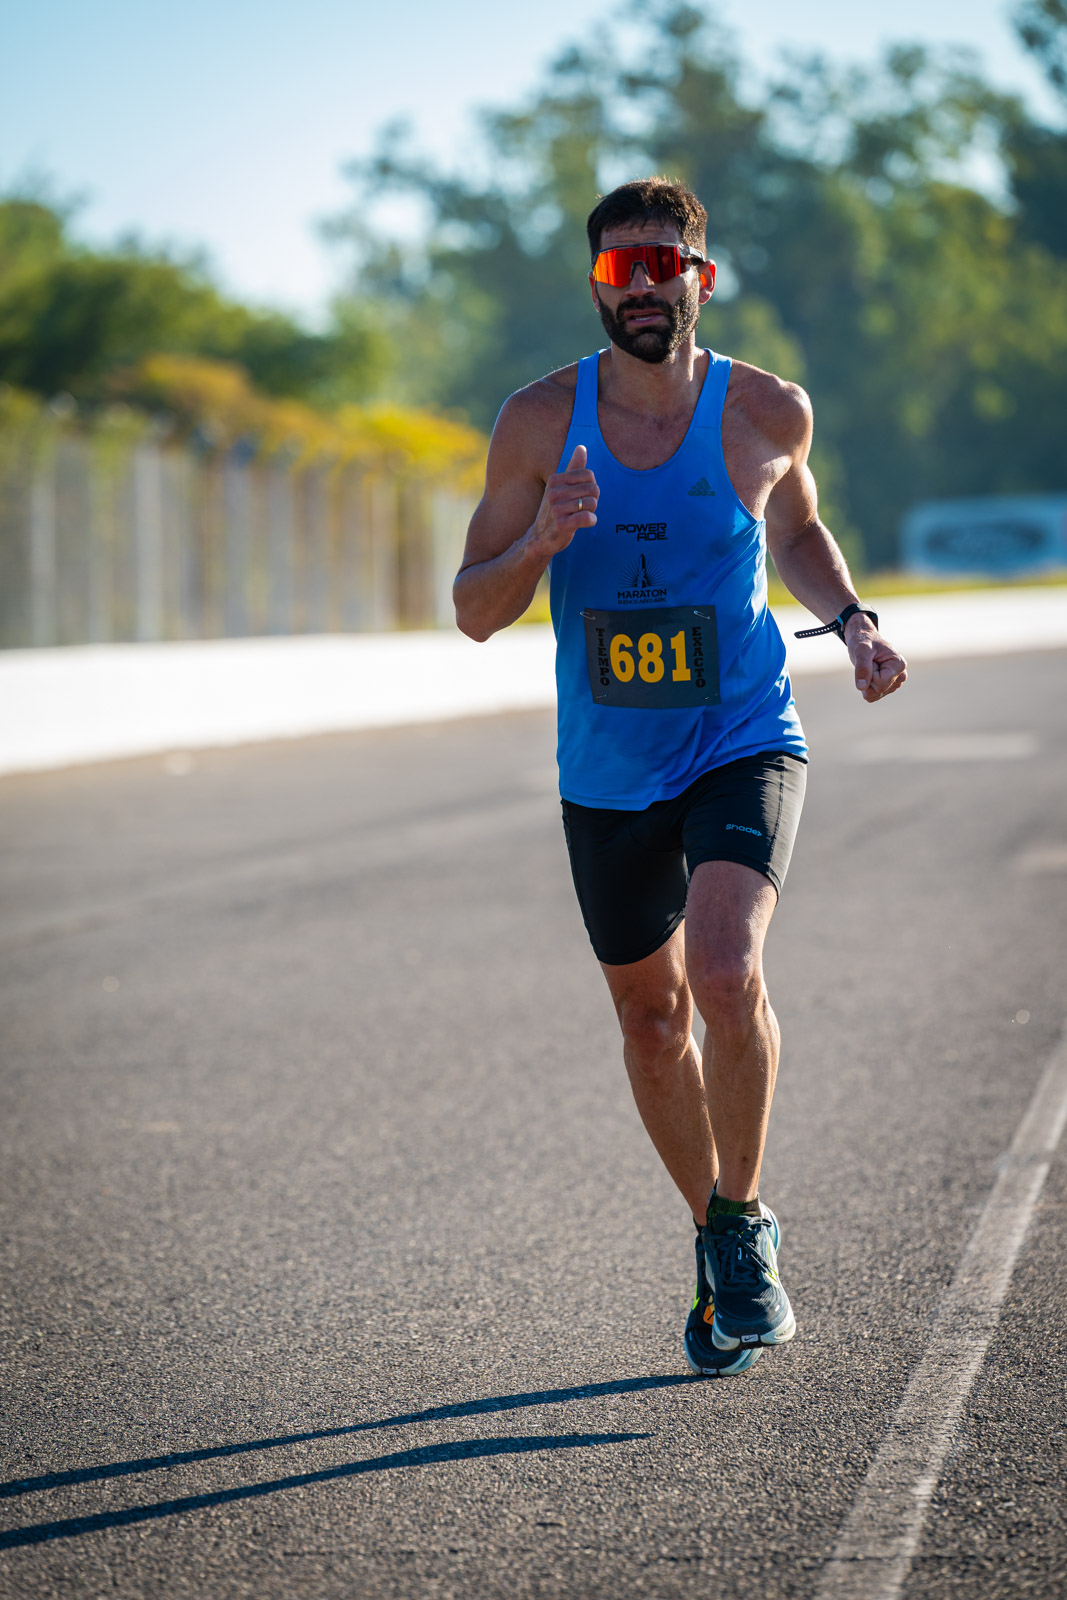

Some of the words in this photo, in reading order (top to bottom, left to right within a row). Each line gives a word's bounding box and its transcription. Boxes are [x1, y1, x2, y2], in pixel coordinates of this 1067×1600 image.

[615, 522, 667, 533] POWER
[617, 588, 667, 599] MARATON
[595, 627, 610, 686] TIEMPO
[609, 630, 691, 684] 681
[691, 626, 706, 688] EXACTO
